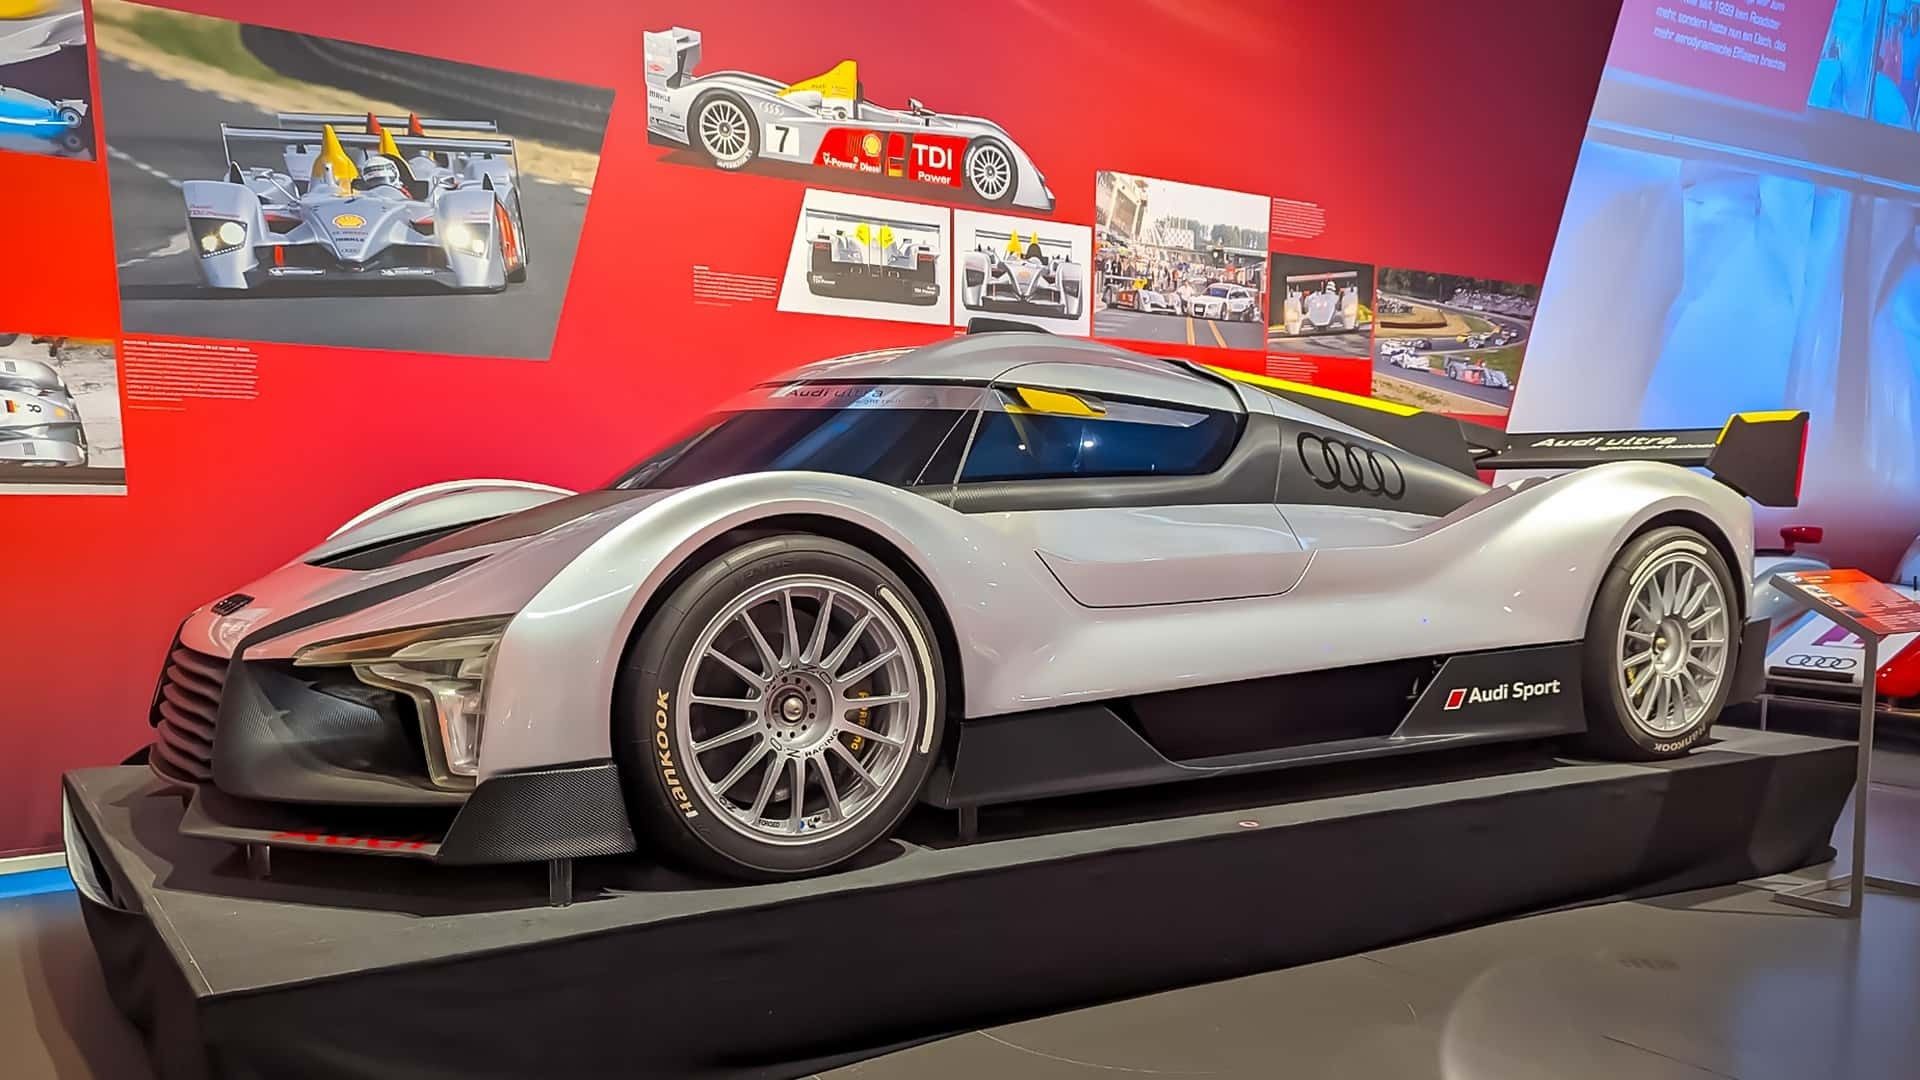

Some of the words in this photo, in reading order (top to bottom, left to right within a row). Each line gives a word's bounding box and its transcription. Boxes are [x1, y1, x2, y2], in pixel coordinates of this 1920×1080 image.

[775, 126, 790, 152] 7
[912, 143, 952, 170] TDI
[918, 171, 951, 185] Power
[790, 387, 828, 398] Audi
[1531, 436, 1604, 448] Audi
[1605, 436, 1678, 446] ultra
[1468, 683, 1509, 704] Audi
[1512, 679, 1561, 701] Sport
[804, 728, 839, 757] RACING
